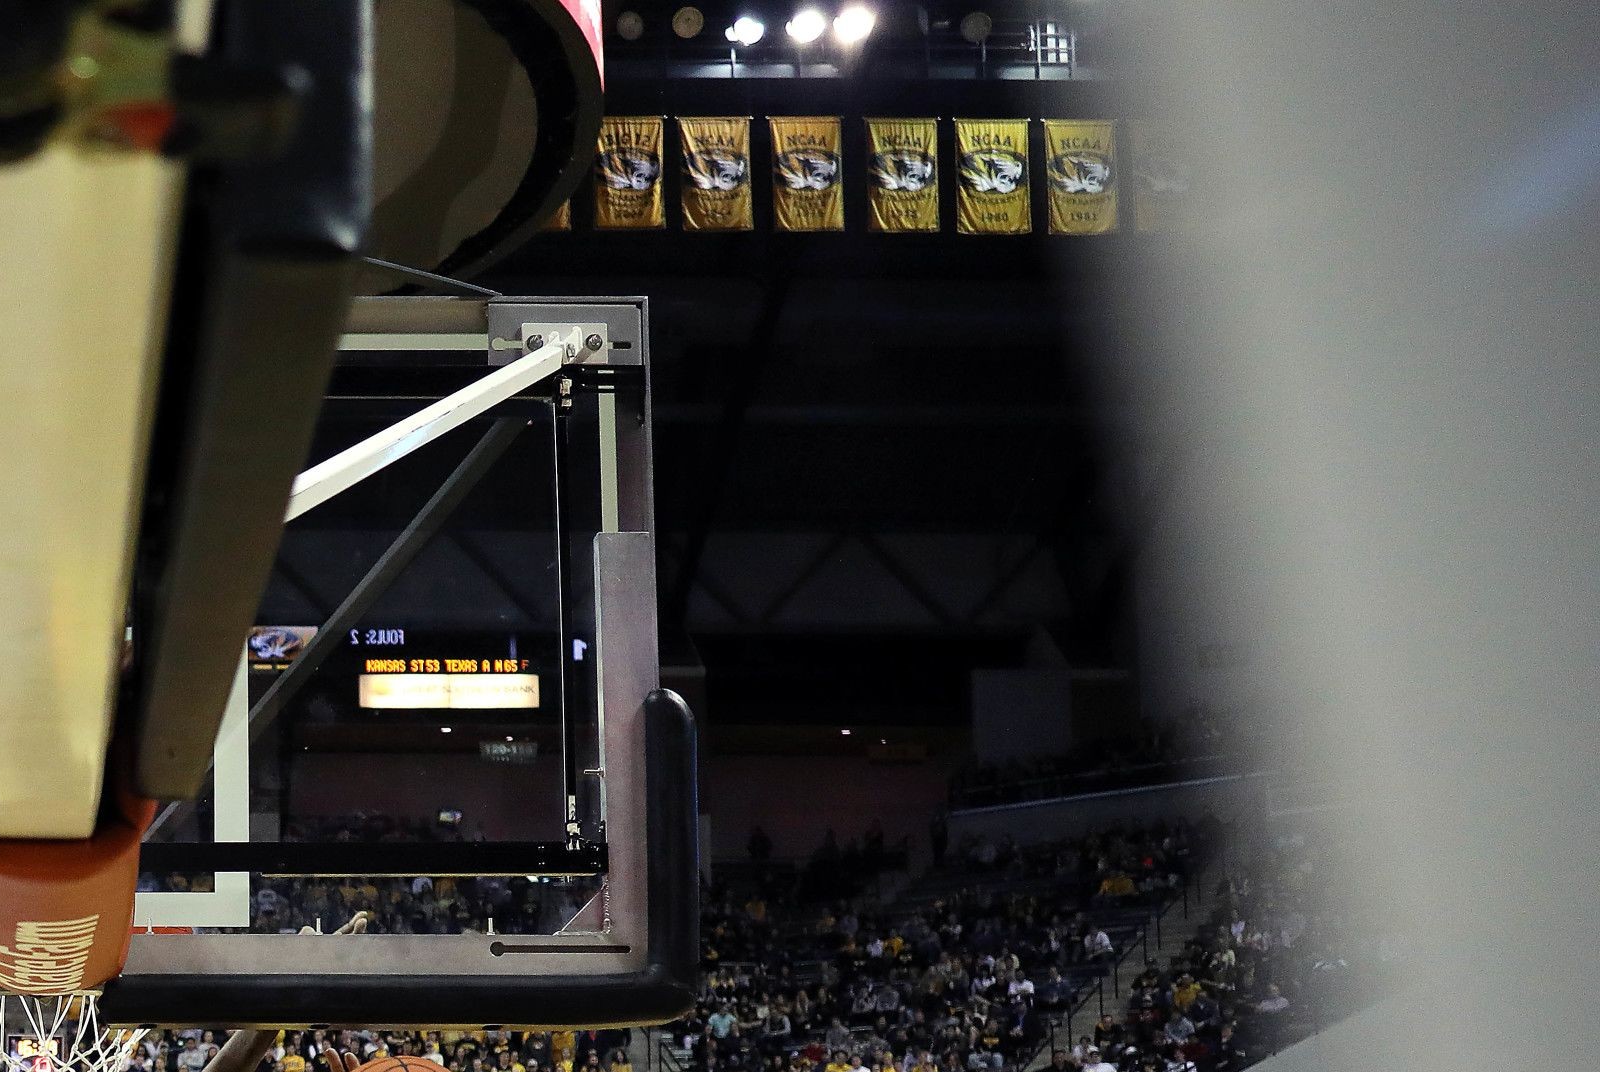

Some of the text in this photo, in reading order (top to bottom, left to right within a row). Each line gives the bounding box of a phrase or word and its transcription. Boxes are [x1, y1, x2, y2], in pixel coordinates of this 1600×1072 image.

[785, 134, 828, 147] NCAA
[881, 134, 922, 149] NCAA
[970, 133, 1012, 148] NCAA
[1060, 135, 1102, 149] NCAA
[365, 659, 406, 673] KANSAS
[444, 659, 478, 673] TEXAS
